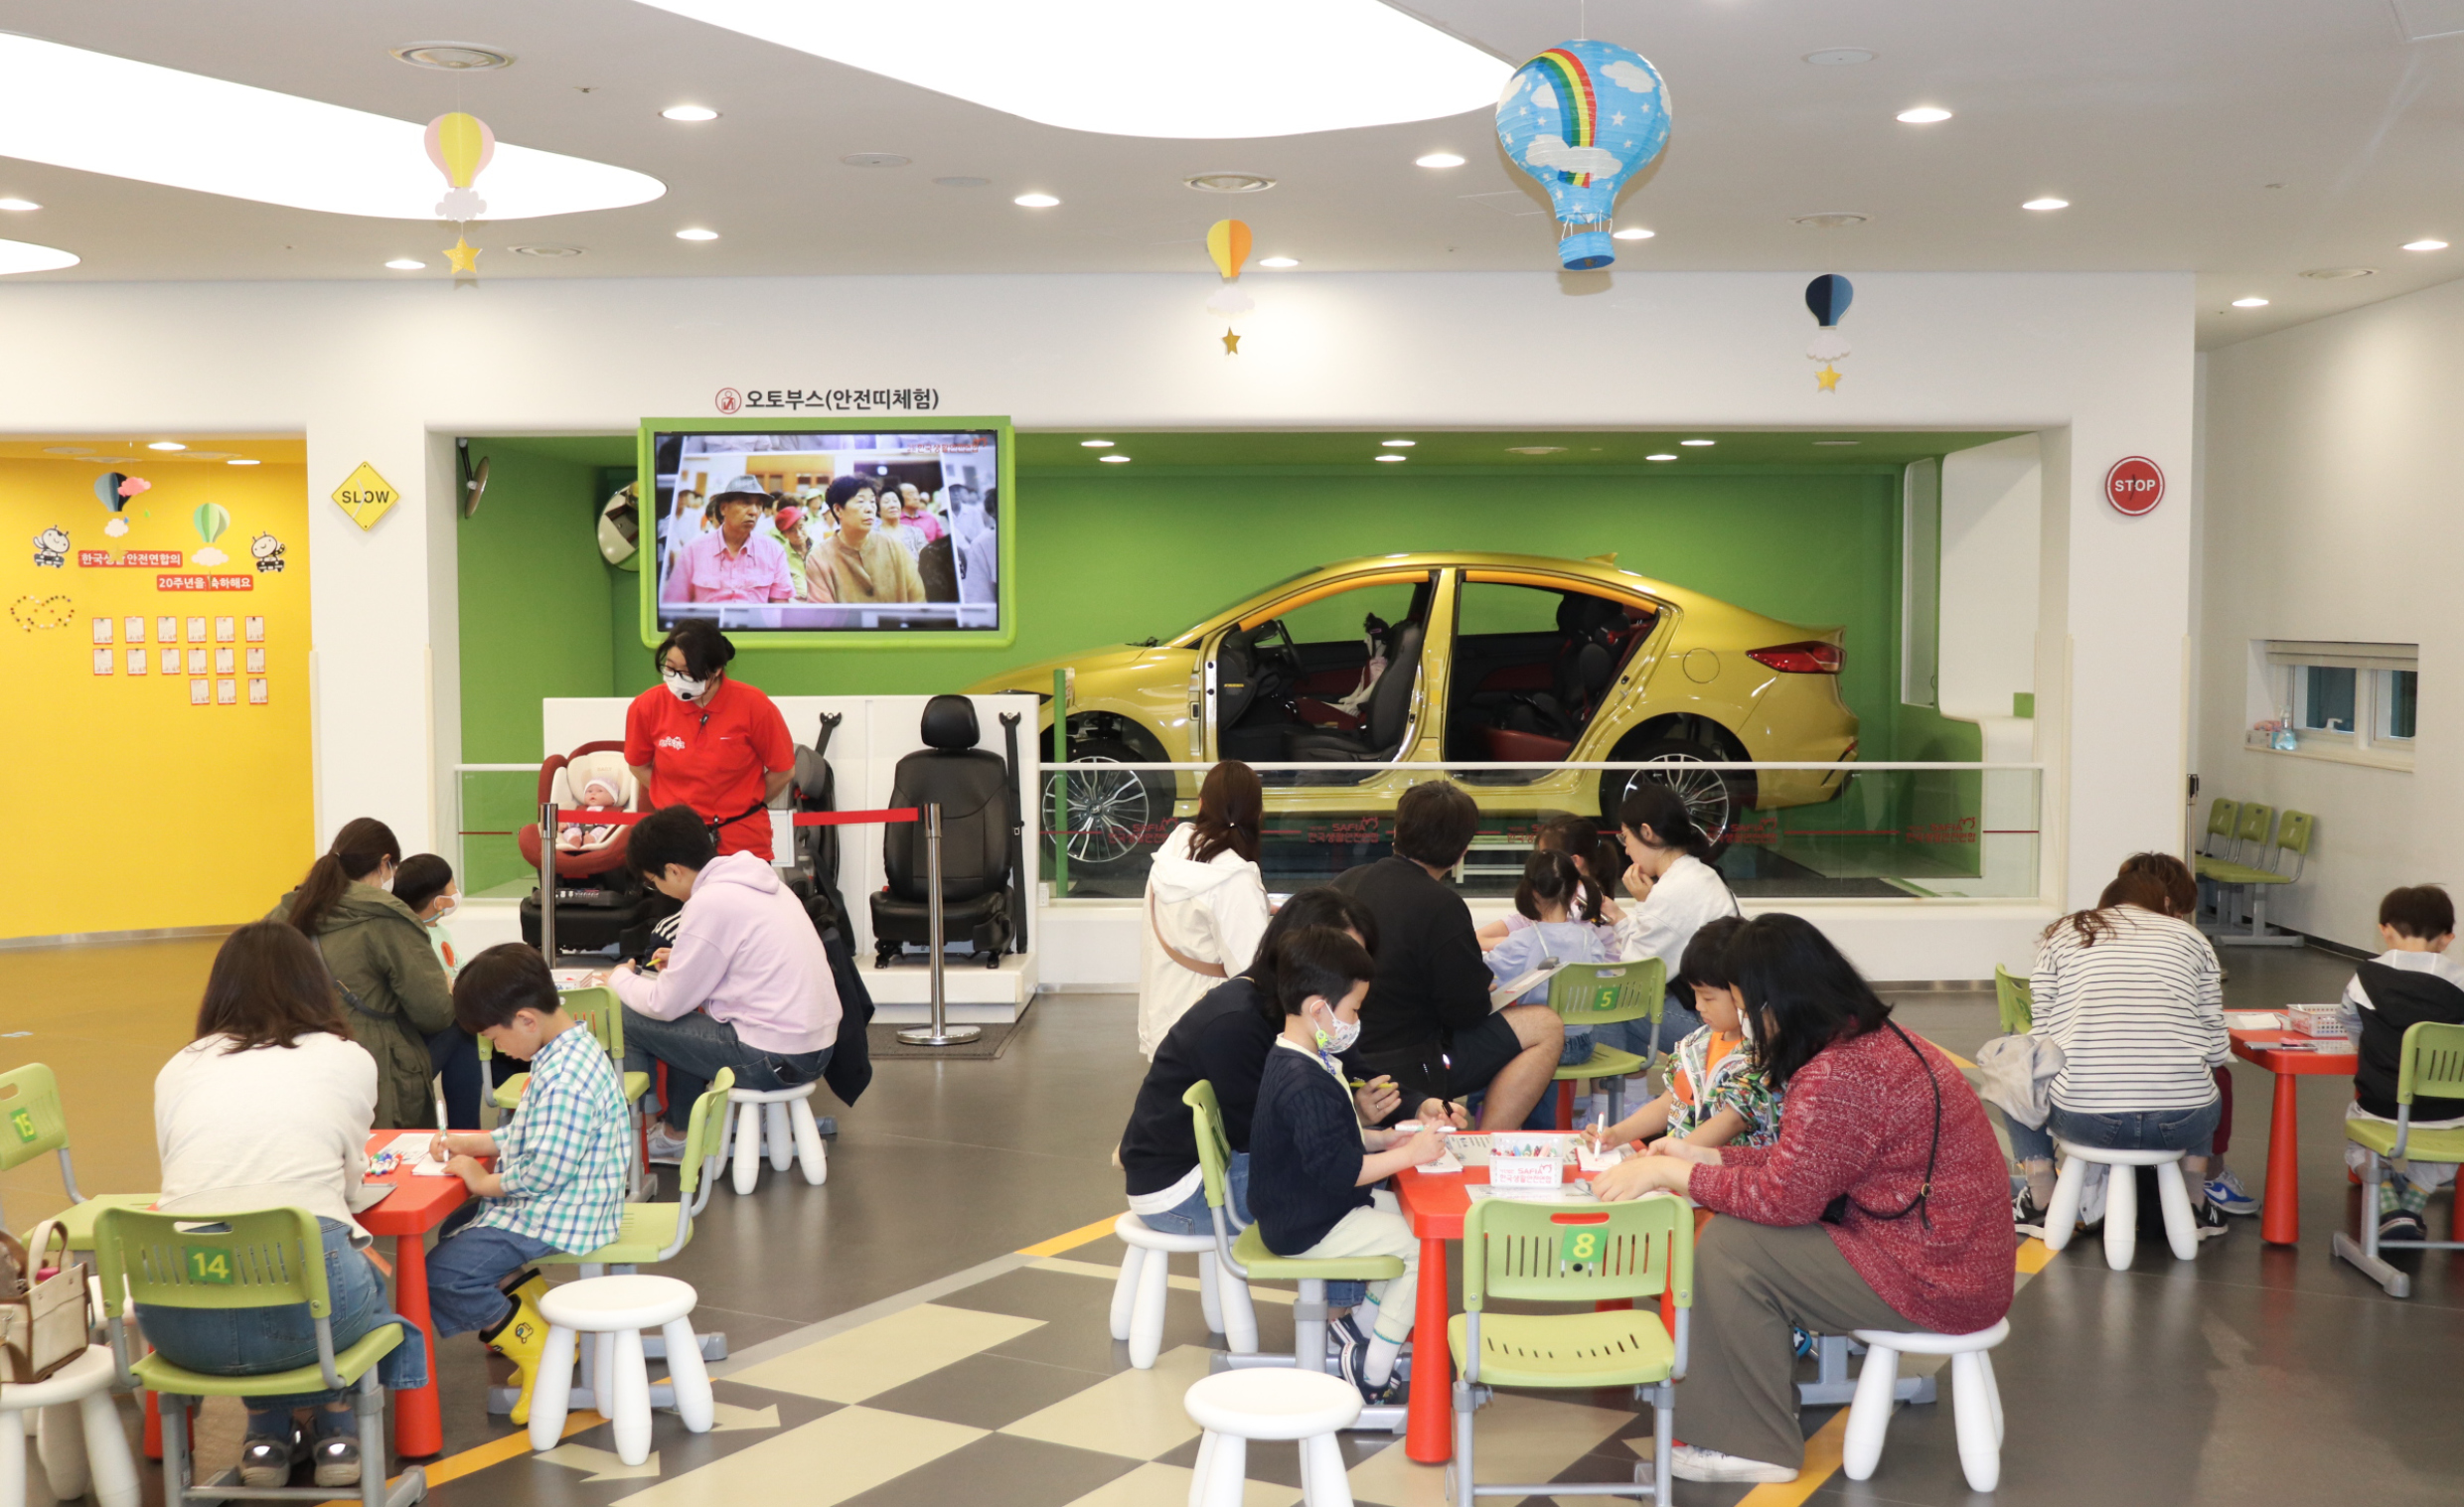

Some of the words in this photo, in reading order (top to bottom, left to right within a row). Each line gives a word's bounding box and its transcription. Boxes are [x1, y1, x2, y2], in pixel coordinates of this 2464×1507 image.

[745, 388, 939, 410] 오토부스(안전띠체험)
[2114, 479, 2156, 492] STOP
[342, 490, 390, 504] SLOW
[159, 577, 205, 590] 20주년을
[1600, 990, 1614, 1007] 5
[15, 1113, 35, 1137] 15
[1572, 1233, 1596, 1258] 8
[193, 1252, 230, 1279] 14
